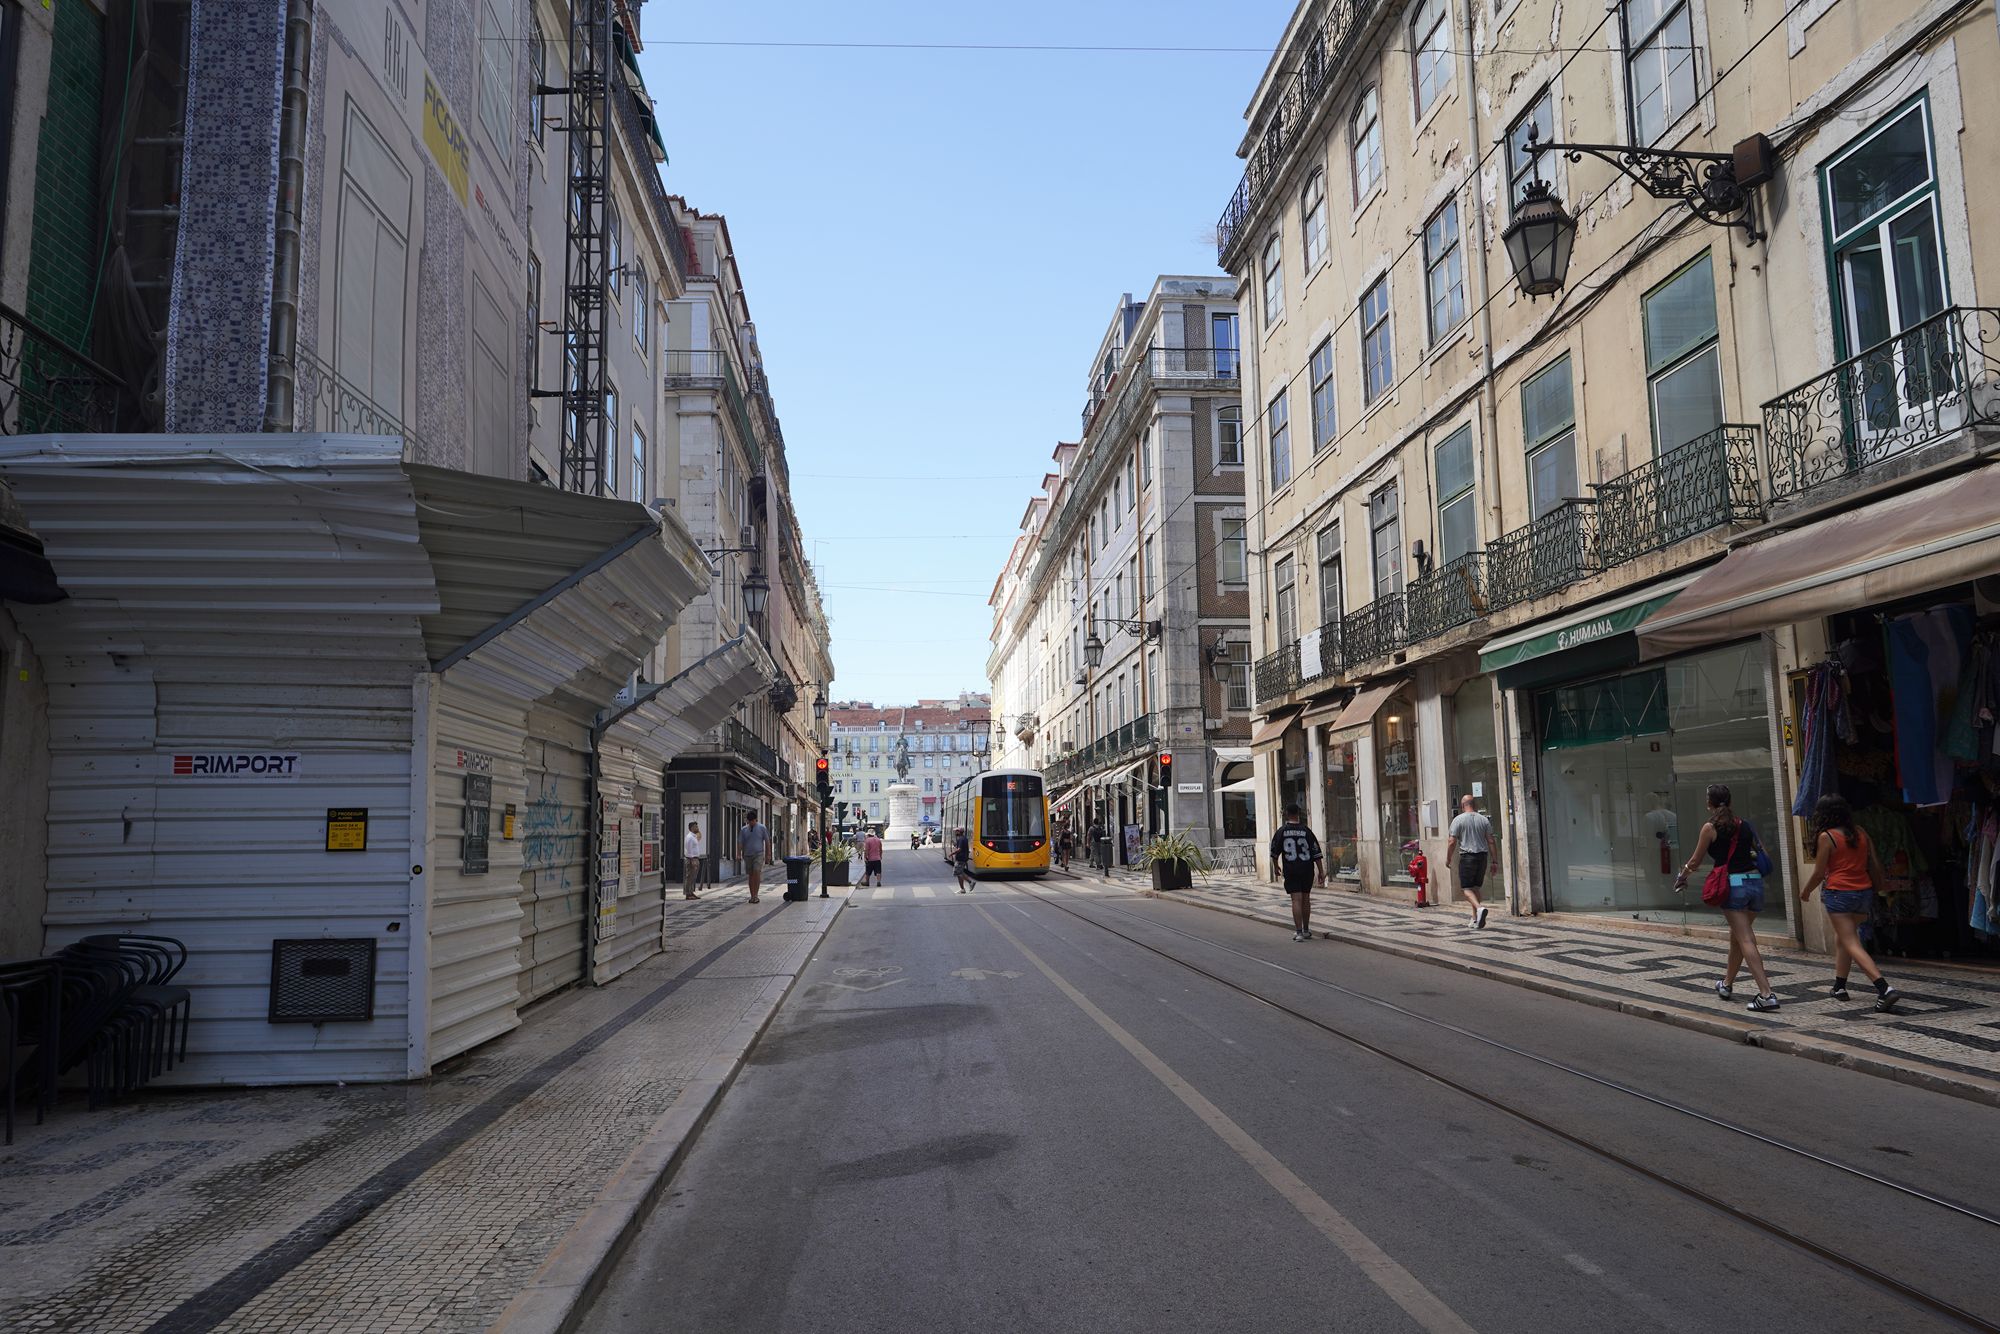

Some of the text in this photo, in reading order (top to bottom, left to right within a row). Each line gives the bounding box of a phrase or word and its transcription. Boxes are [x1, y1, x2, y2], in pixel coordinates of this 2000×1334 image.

[424, 72, 470, 172] FICOPE
[1568, 619, 1613, 646] HUMANA
[1283, 838, 1311, 861] 93
